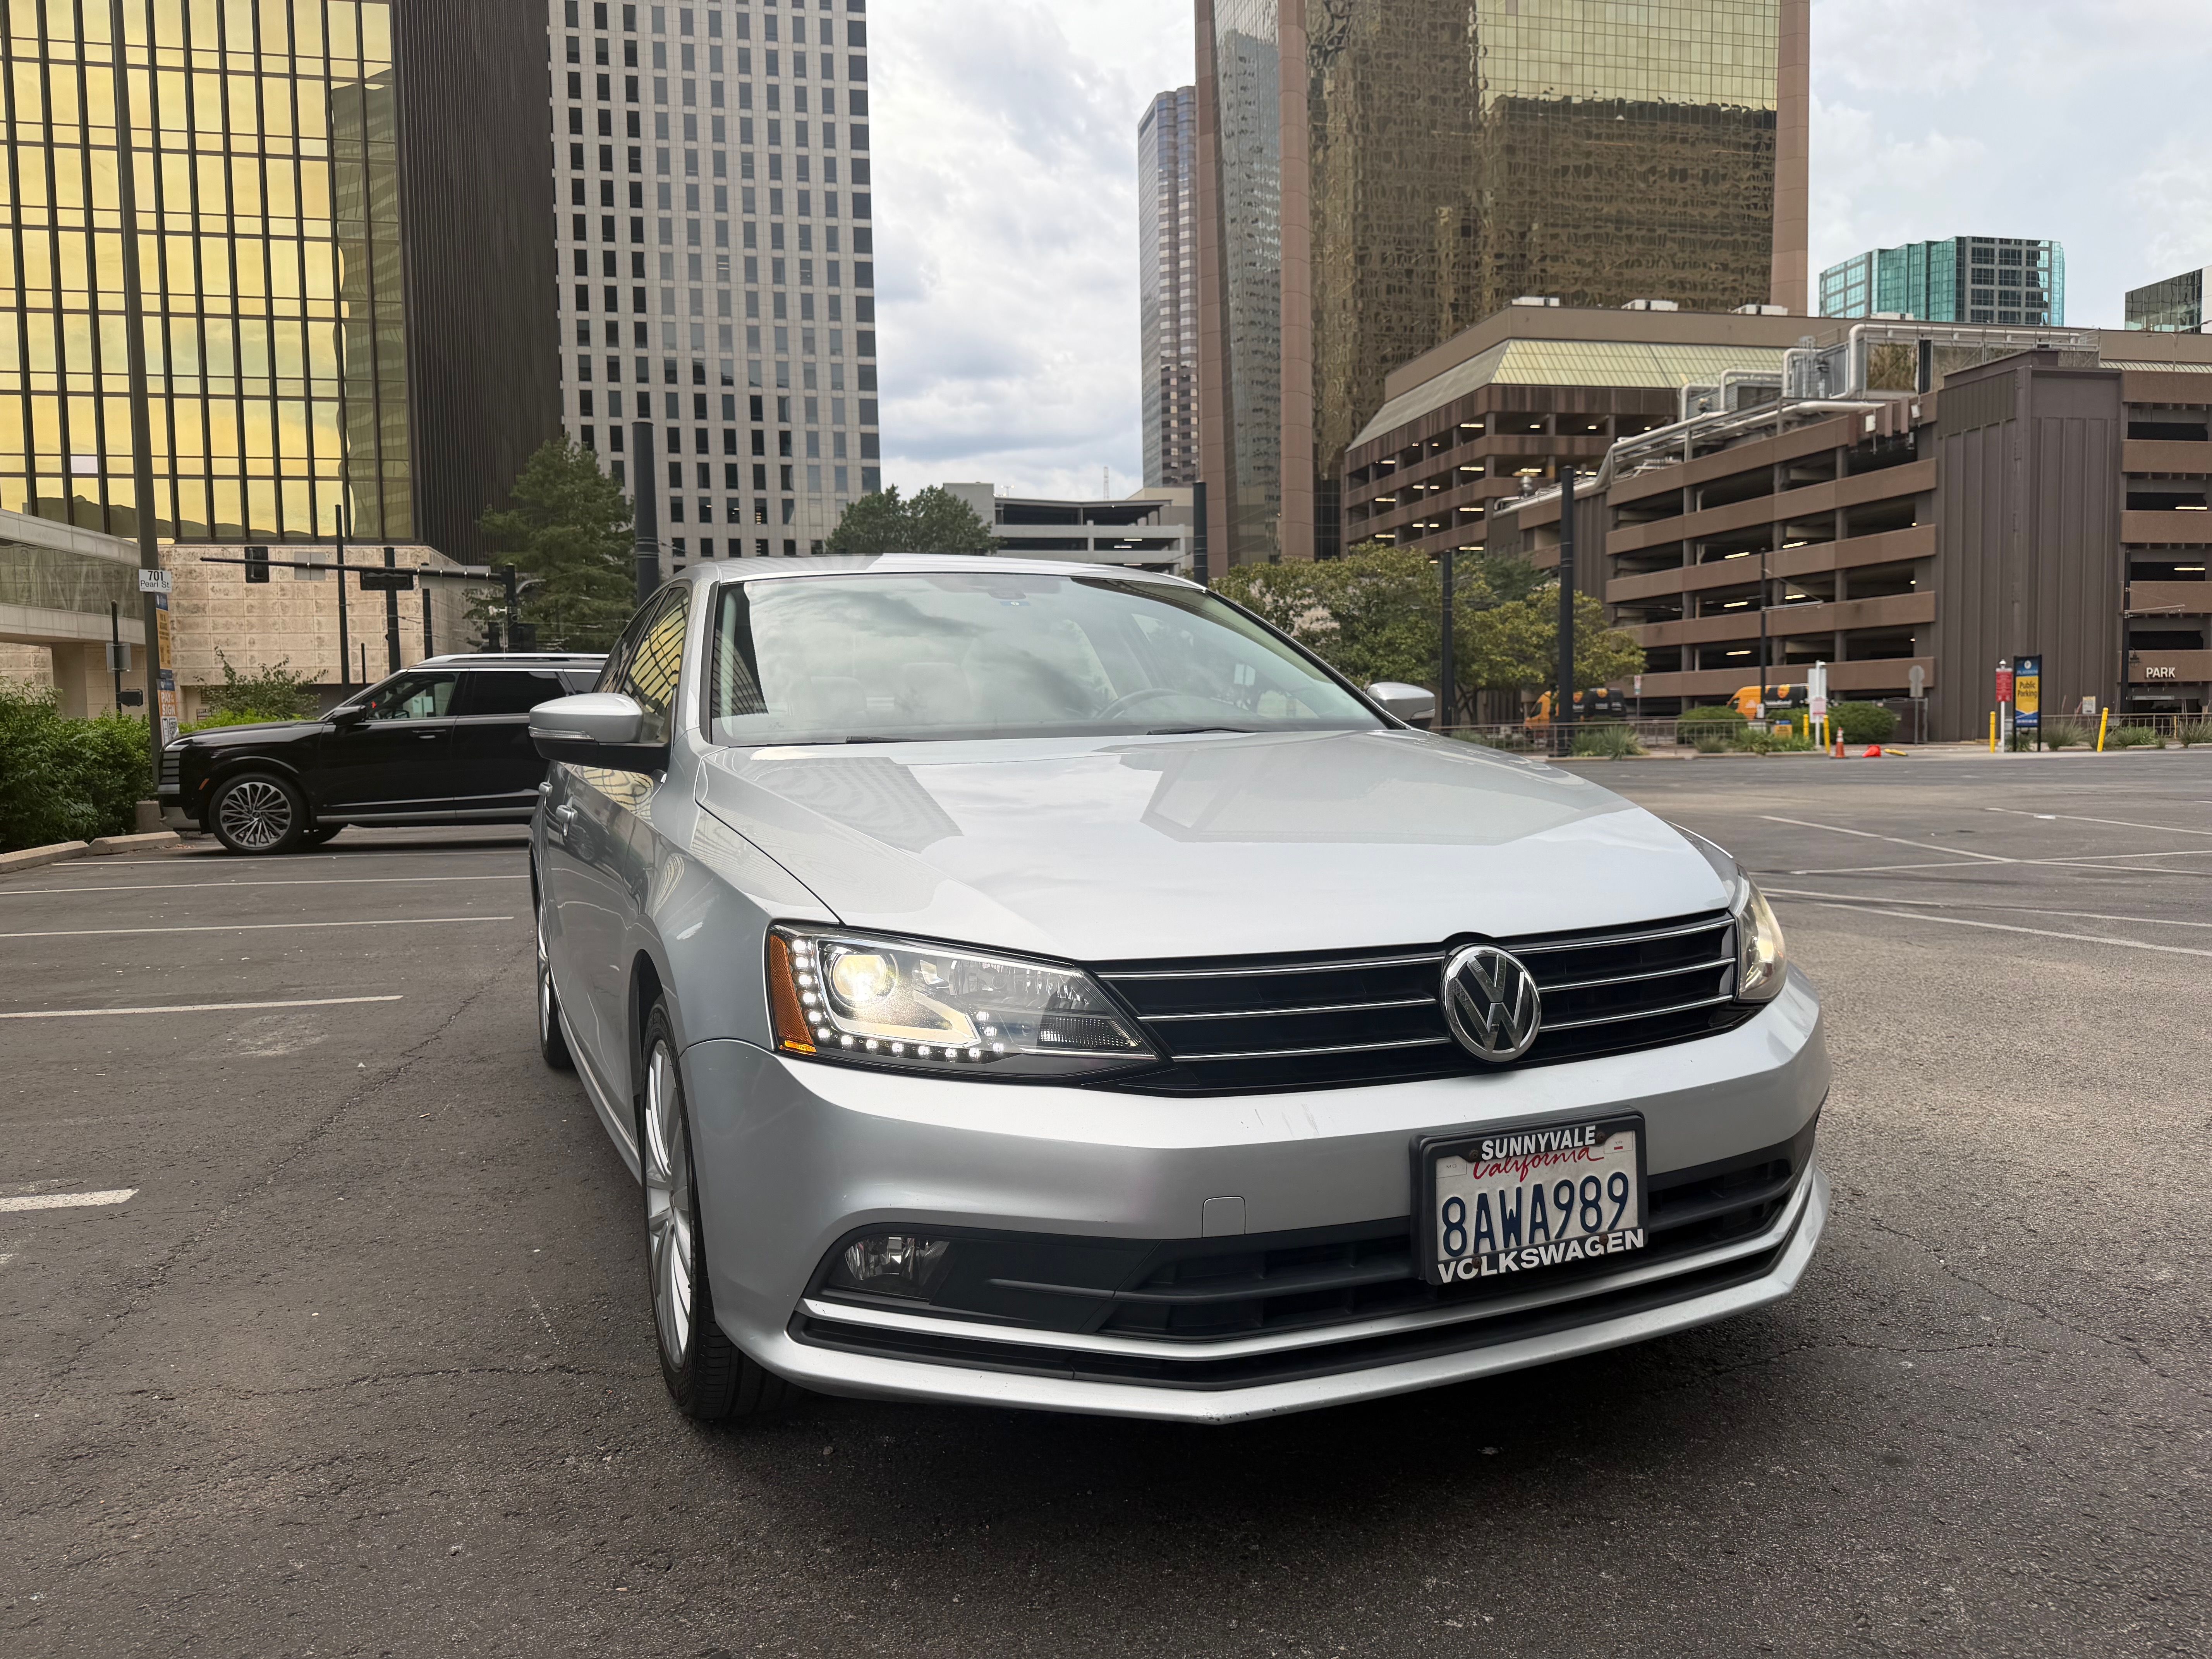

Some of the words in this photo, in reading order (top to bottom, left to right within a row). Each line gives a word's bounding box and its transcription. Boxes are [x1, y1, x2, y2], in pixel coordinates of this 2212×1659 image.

[148, 570, 163, 581] 701
[2146, 667, 2175, 678] PARK
[2019, 680, 2036, 689] Public
[161, 692, 171, 703] PAY
[2017, 690, 2037, 699] Parking
[162, 704, 175, 715] SIGN
[1448, 949, 1532, 1051] VW
[1481, 1125, 1596, 1160] SUNNYVALE
[1473, 1146, 1604, 1182] California
[1442, 1171, 1628, 1257] 8AWA989
[1437, 1228, 1644, 1283] VOLKSWAGEN
